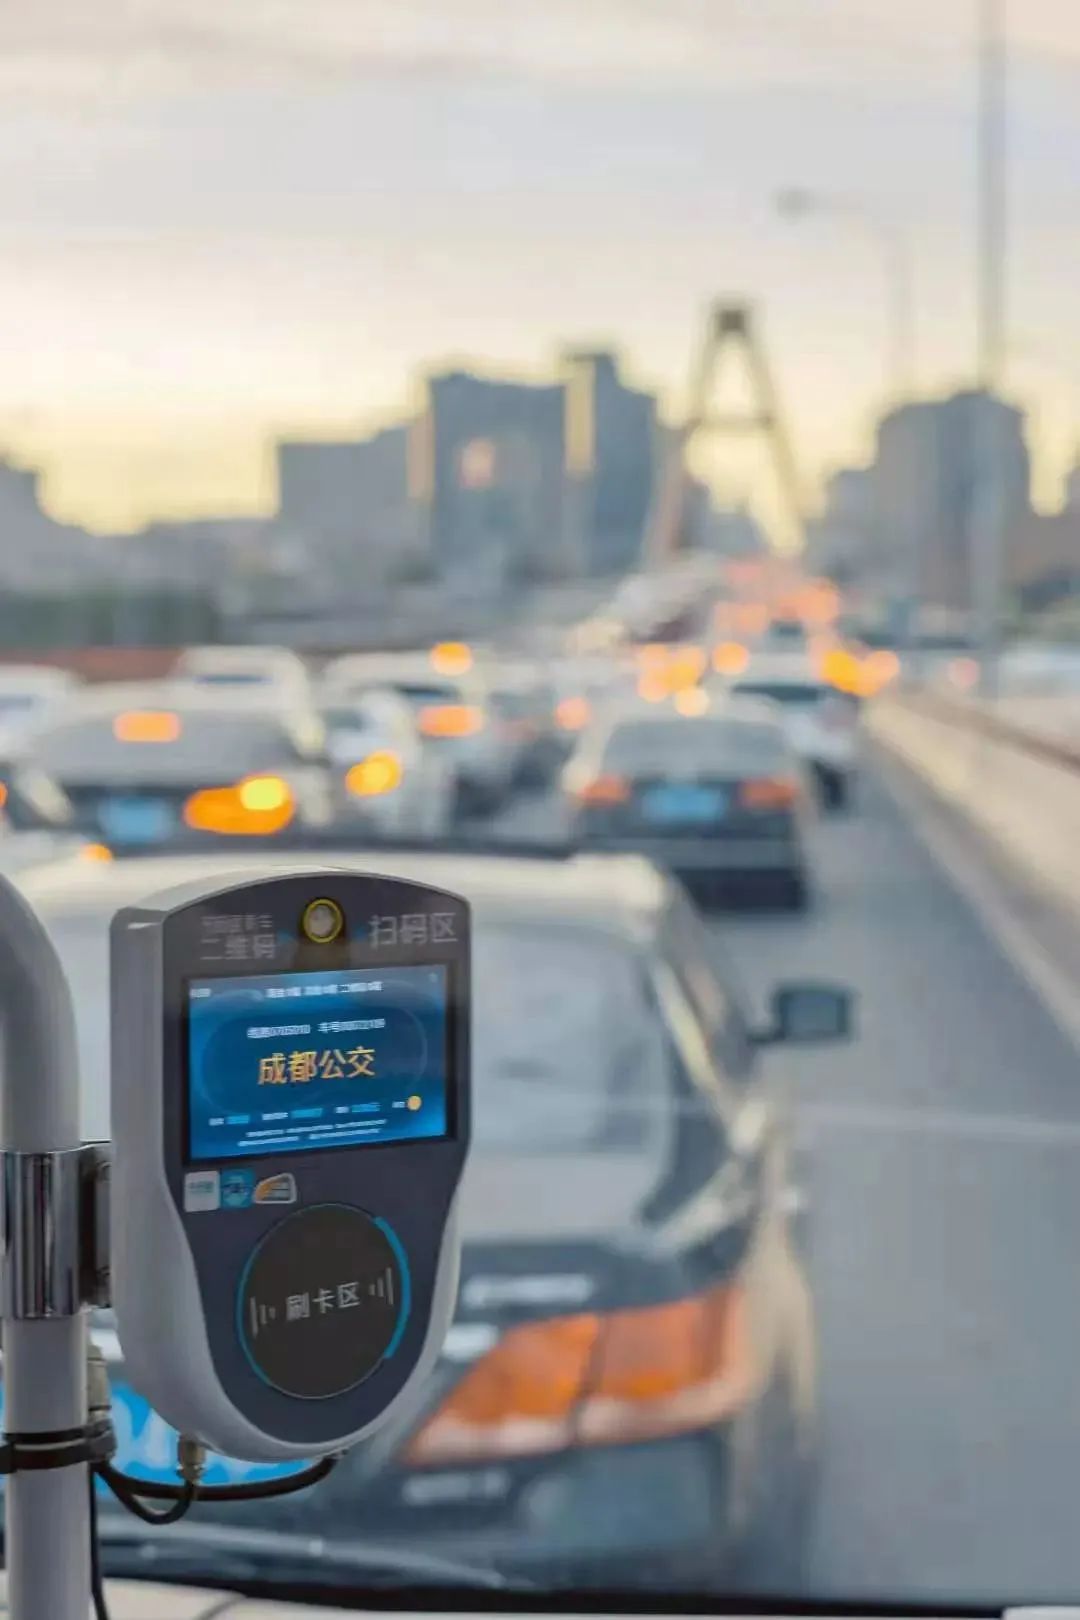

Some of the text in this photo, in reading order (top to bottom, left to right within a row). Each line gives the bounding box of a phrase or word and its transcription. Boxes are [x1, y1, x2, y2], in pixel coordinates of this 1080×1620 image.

[368, 912, 458, 950] 扫码区
[257, 1045, 376, 1086] 成都公交
[286, 1281, 360, 1322] 刷卡区
